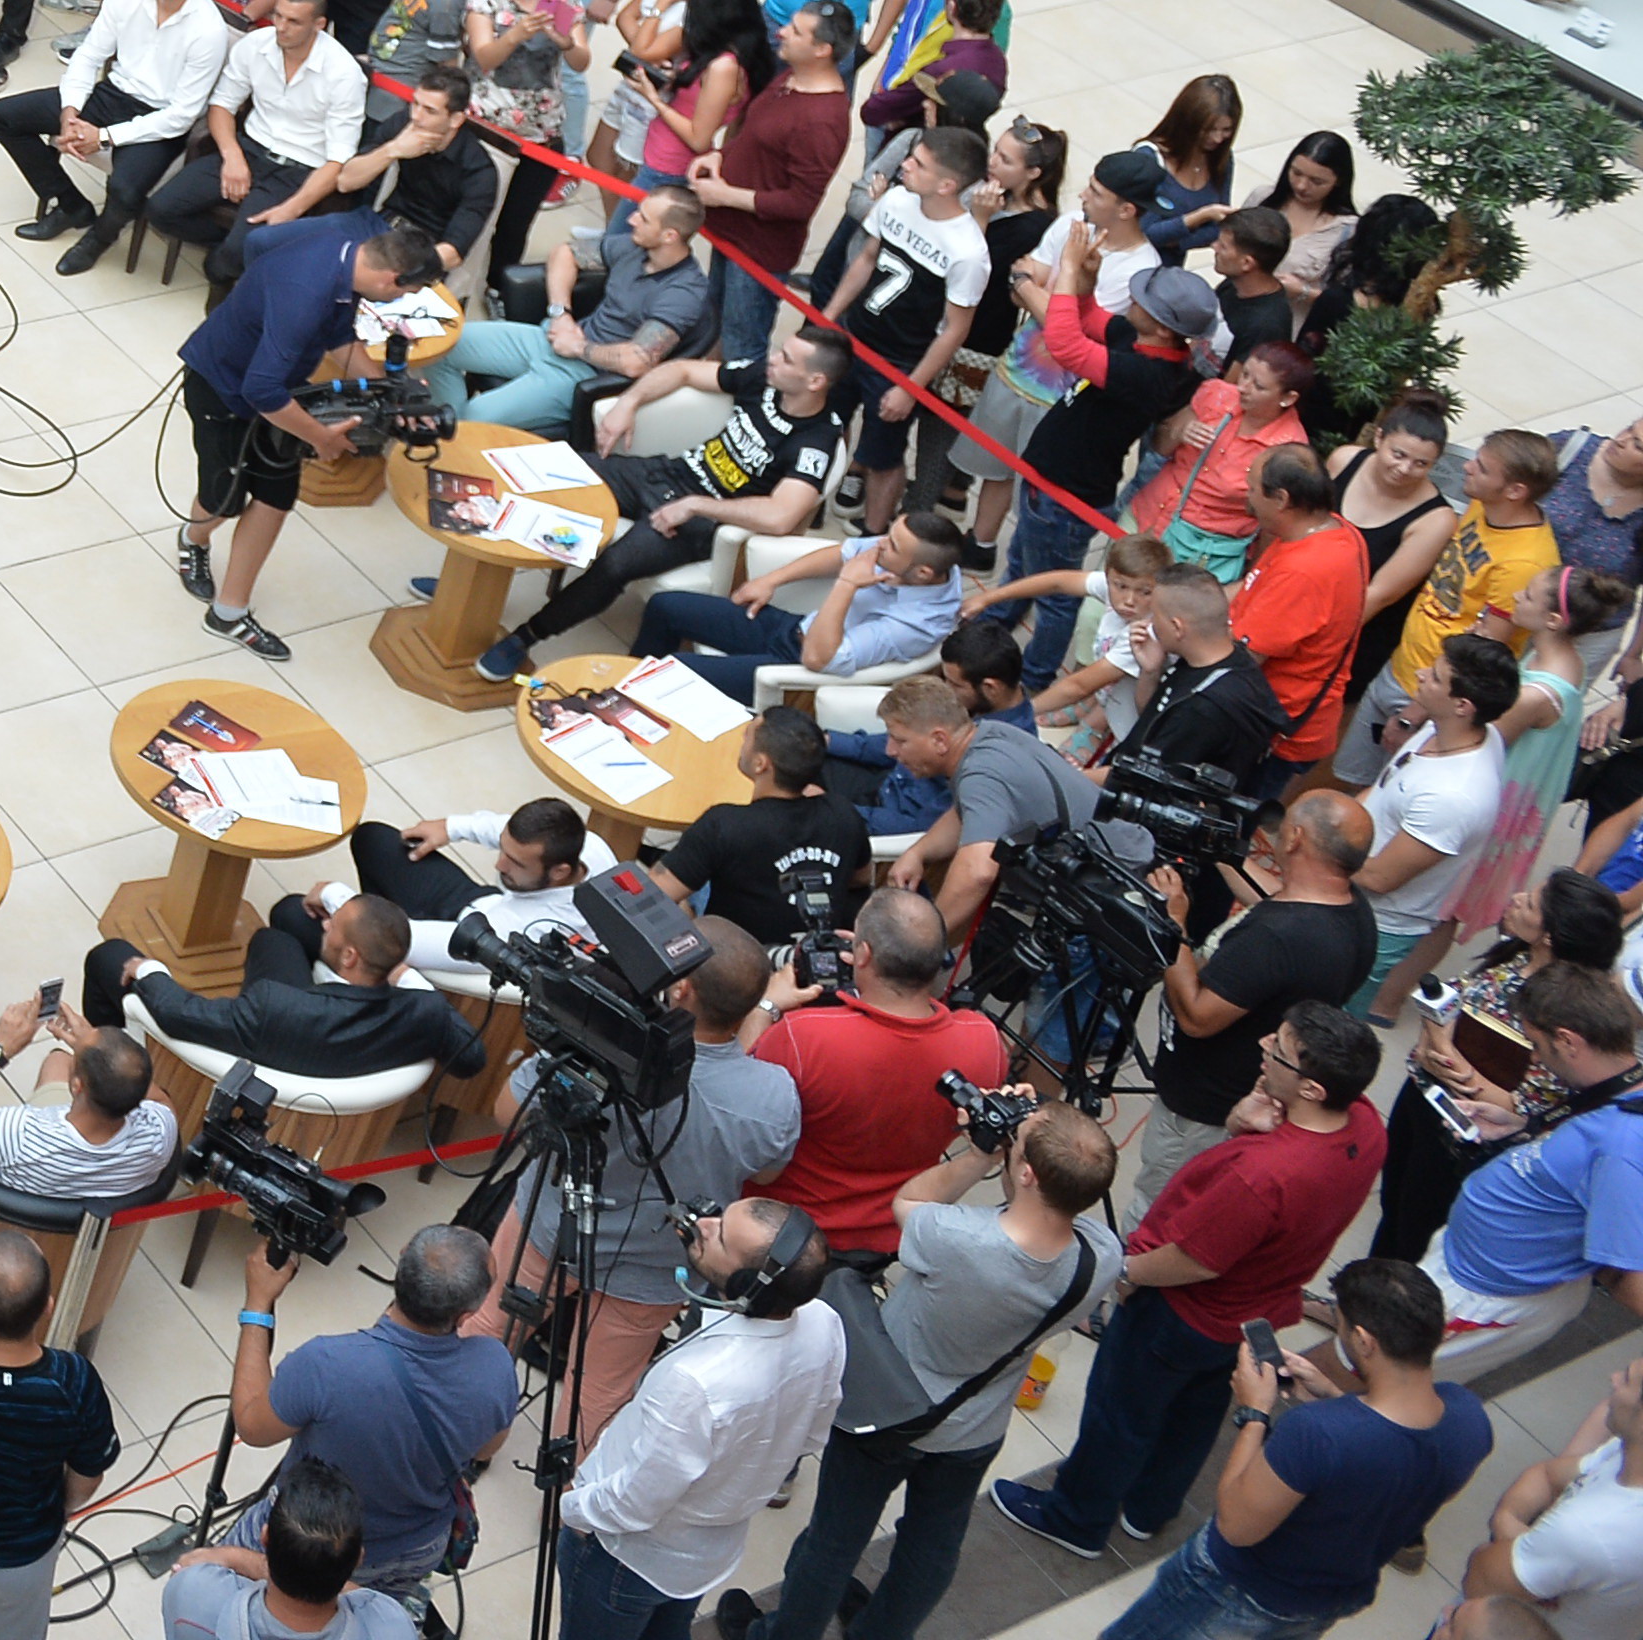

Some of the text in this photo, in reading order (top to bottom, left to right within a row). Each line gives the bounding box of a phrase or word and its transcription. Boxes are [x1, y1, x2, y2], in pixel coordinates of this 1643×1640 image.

[880, 212, 950, 272] LAS VEGAS
[863, 246, 913, 317] 7
